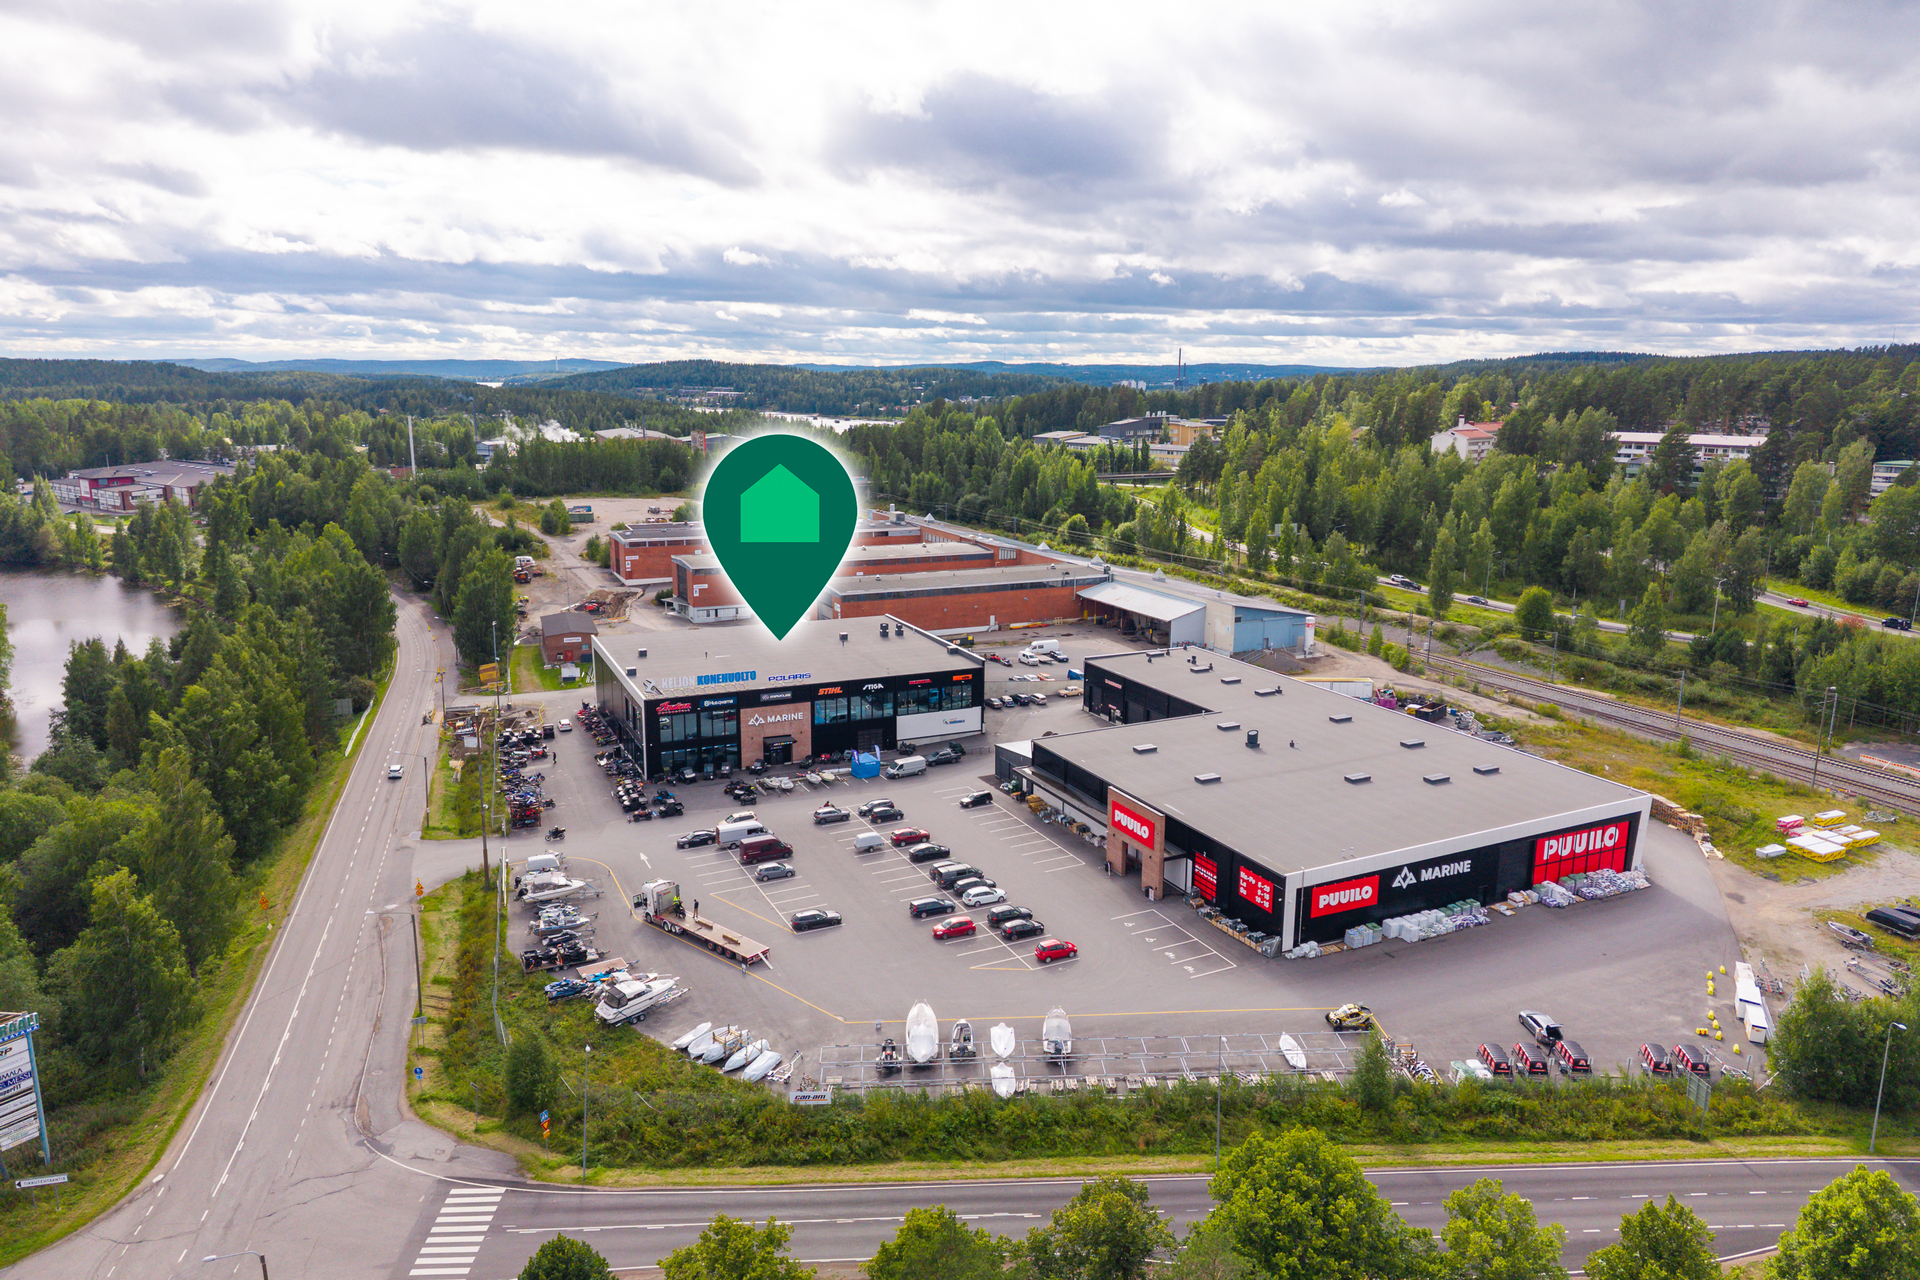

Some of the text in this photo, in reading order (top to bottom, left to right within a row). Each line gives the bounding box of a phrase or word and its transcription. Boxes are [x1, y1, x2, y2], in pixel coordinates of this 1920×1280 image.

[697, 670, 757, 686] KONEHUOLTO
[768, 672, 812, 682] POLARIS
[818, 686, 843, 696] STIHL
[862, 683, 884, 691] STIGA
[767, 712, 804, 723] MARINE
[1114, 809, 1149, 839] PUUILO
[1543, 826, 1619, 860] PUUILO
[1195, 864, 1217, 884] PUUILO
[1420, 860, 1472, 882] MARINE
[1318, 885, 1373, 909] PUUILO
